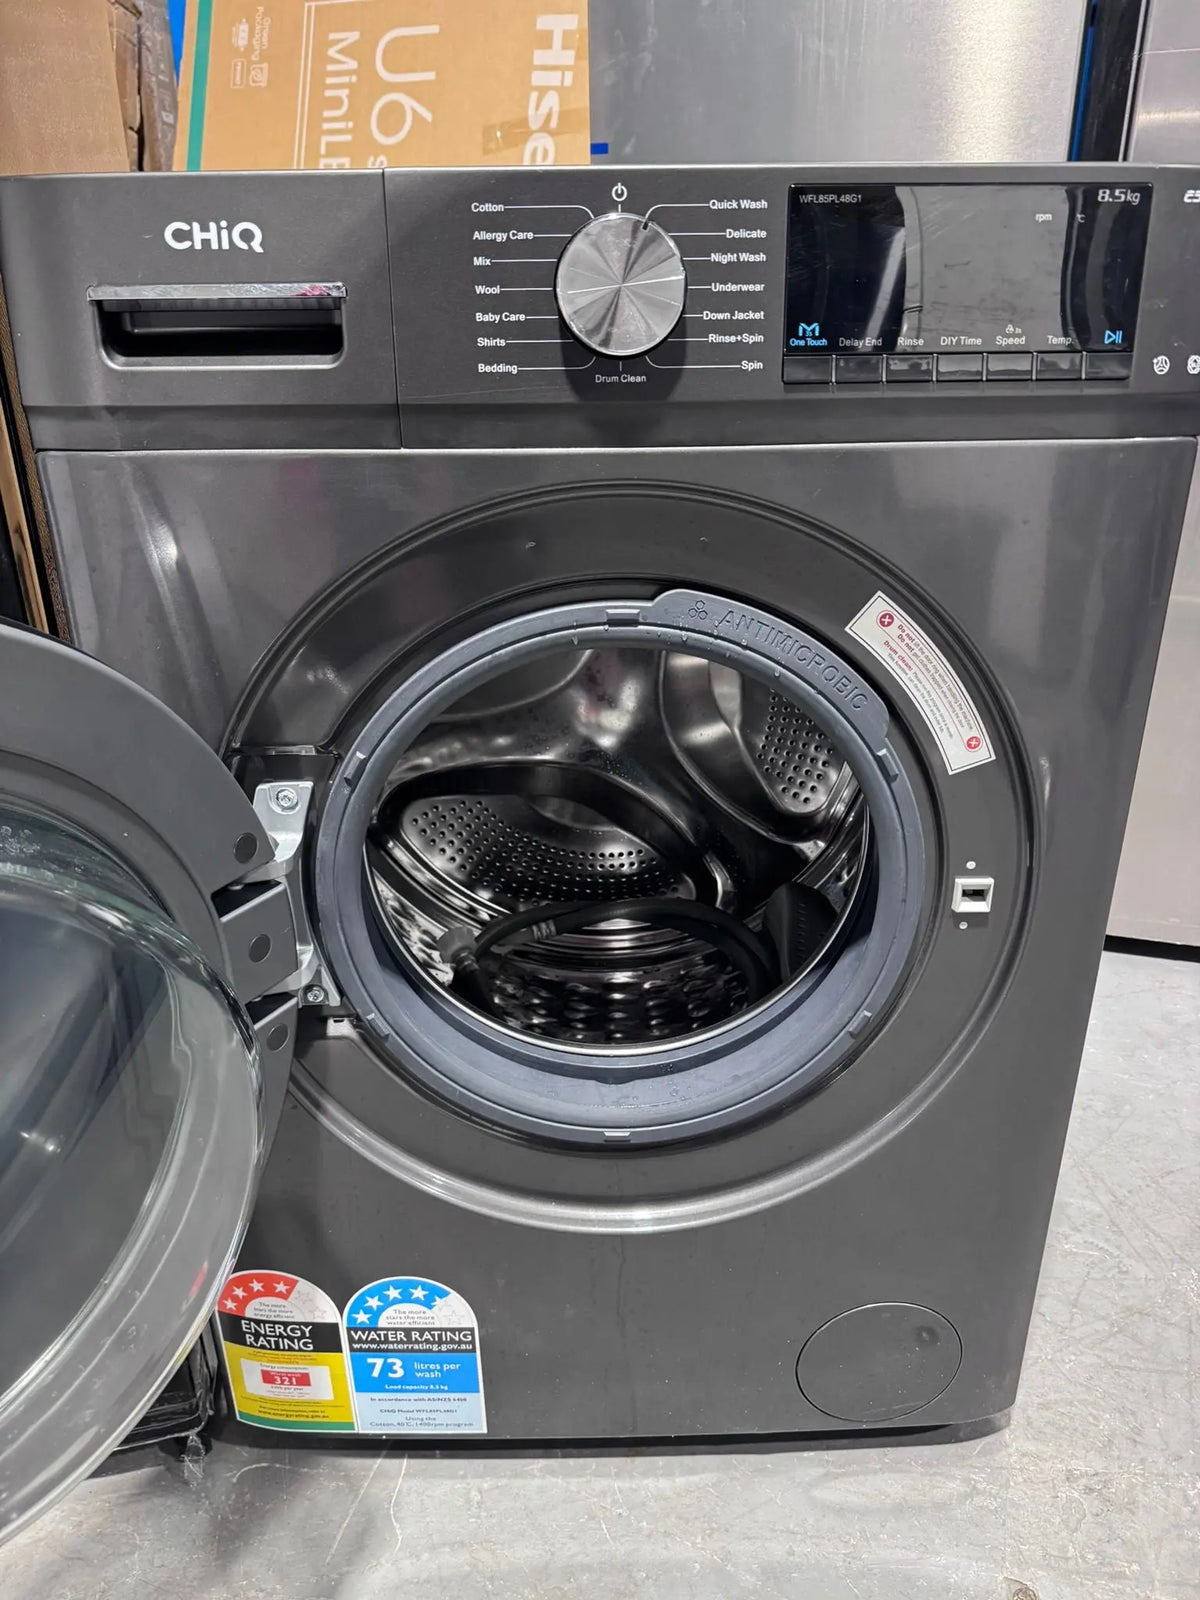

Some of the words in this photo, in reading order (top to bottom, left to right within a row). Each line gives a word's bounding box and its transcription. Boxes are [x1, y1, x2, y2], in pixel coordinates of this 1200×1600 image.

[370, 25, 440, 145] U6
[522, 14, 578, 166] Hise
[709, 199, 738, 210] Quick
[740, 199, 768, 209] Wash
[799, 194, 862, 204] WFL85PL48G1
[471, 202, 505, 213] Cotton
[1035, 213, 1053, 223] rpm
[163, 219, 264, 253] CHiQ
[473, 231, 507, 242] Allergy
[509, 230, 534, 240] Care
[725, 228, 767, 239] Delicate
[473, 256, 492, 266] Mix
[710, 252, 738, 264] Night
[739, 252, 767, 262] Wash
[475, 284, 501, 295] Wool
[711, 282, 765, 292] Underwear
[475, 312, 500, 324] Baby
[501, 312, 526, 322] Care
[702, 311, 731, 320] Down
[731, 310, 765, 320] Jacket
[477, 336, 506, 347] Shirts
[708, 333, 764, 345] Rinse+Spin
[790, 338, 806, 347] One
[806, 337, 828, 347] Touch
[839, 338, 864, 348] Delay
[865, 337, 882, 347] End
[897, 336, 925, 347] Rinse
[940, 336, 958, 346] DIY
[959, 336, 983, 346] Time
[995, 335, 1026, 346] Speed
[478, 363, 518, 375] Bedding
[741, 360, 763, 371] Spin
[595, 374, 619, 383] Drum
[620, 374, 647, 383] Clean
[898, 624, 906, 633] Do
[905, 632, 915, 643] not
[884, 640, 898, 655] Drum
[897, 633, 905, 643] Do
[905, 642, 915, 652] not
[241, 1319, 313, 1337] ENERGY
[350, 1330, 407, 1341] WATER
[411, 1330, 472, 1341] RATING
[245, 1334, 314, 1351] RATING
[352, 1342, 472, 1351] www.waterrating.gov.au
[366, 1357, 405, 1378] 73
[414, 1361, 440, 1369] litres
[443, 1363, 461, 1371] per
[415, 1369, 441, 1378] wash
[274, 1376, 296, 1385] 321
